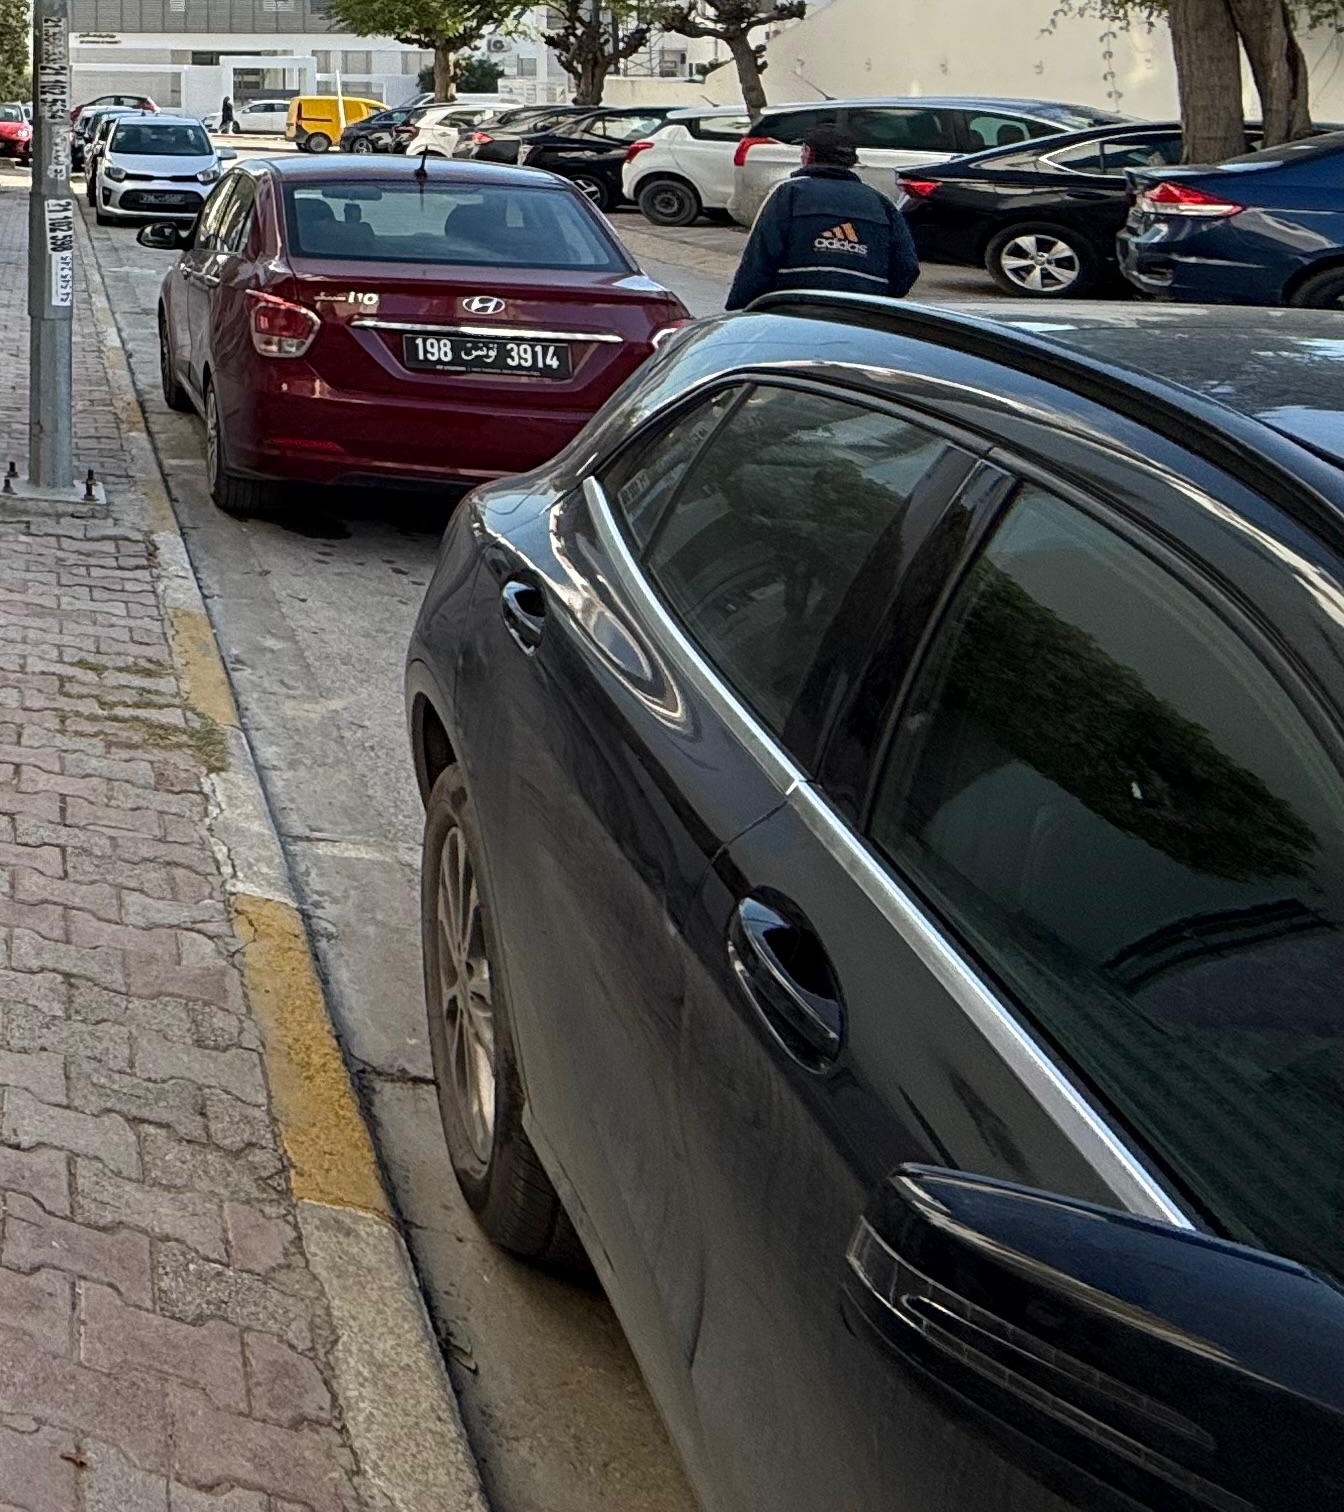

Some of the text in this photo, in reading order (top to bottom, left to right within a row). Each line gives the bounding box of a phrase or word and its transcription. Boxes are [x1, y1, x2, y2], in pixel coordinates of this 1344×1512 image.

[48, 216, 73, 233] 102
[50, 235, 74, 253] 598
[814, 238, 868, 255] adidas
[415, 337, 560, 369] 198 تونس 3914
